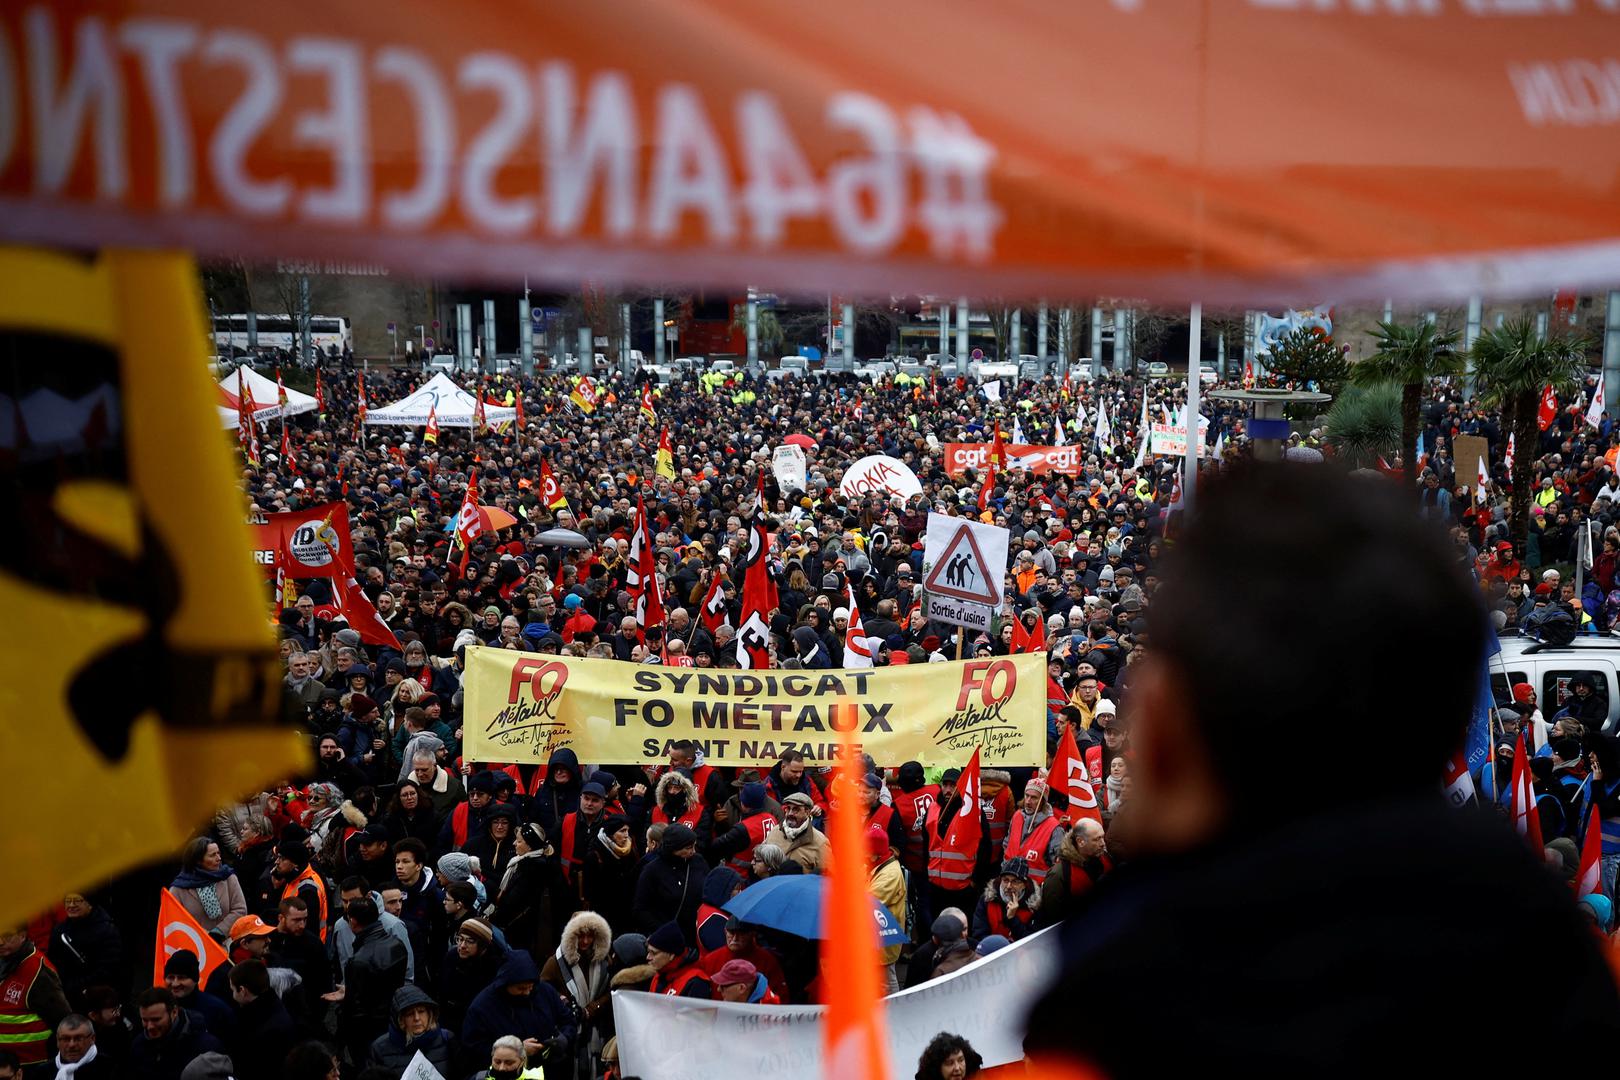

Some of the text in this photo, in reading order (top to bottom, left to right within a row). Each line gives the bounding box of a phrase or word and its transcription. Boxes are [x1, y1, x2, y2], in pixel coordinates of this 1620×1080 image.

[954, 447, 987, 468] cgt
[1045, 447, 1078, 469] cgt
[843, 462, 902, 499] NOKIA
[931, 602, 986, 626] Sortie d'usine
[508, 657, 569, 705] FO
[633, 670, 875, 697] SYNDICAT
[955, 659, 1017, 712] FO
[486, 692, 560, 732] Métaux
[613, 697, 894, 733] FO MÉTAUX
[933, 697, 1008, 739] Métaux
[500, 721, 573, 747] Saint-Nazaire
[947, 725, 1024, 751] Saint-Nazaire
[532, 739, 573, 757] et région
[643, 738, 730, 759] SANT
[983, 741, 1024, 759] et région
[6, 987, 22, 999] cgt
